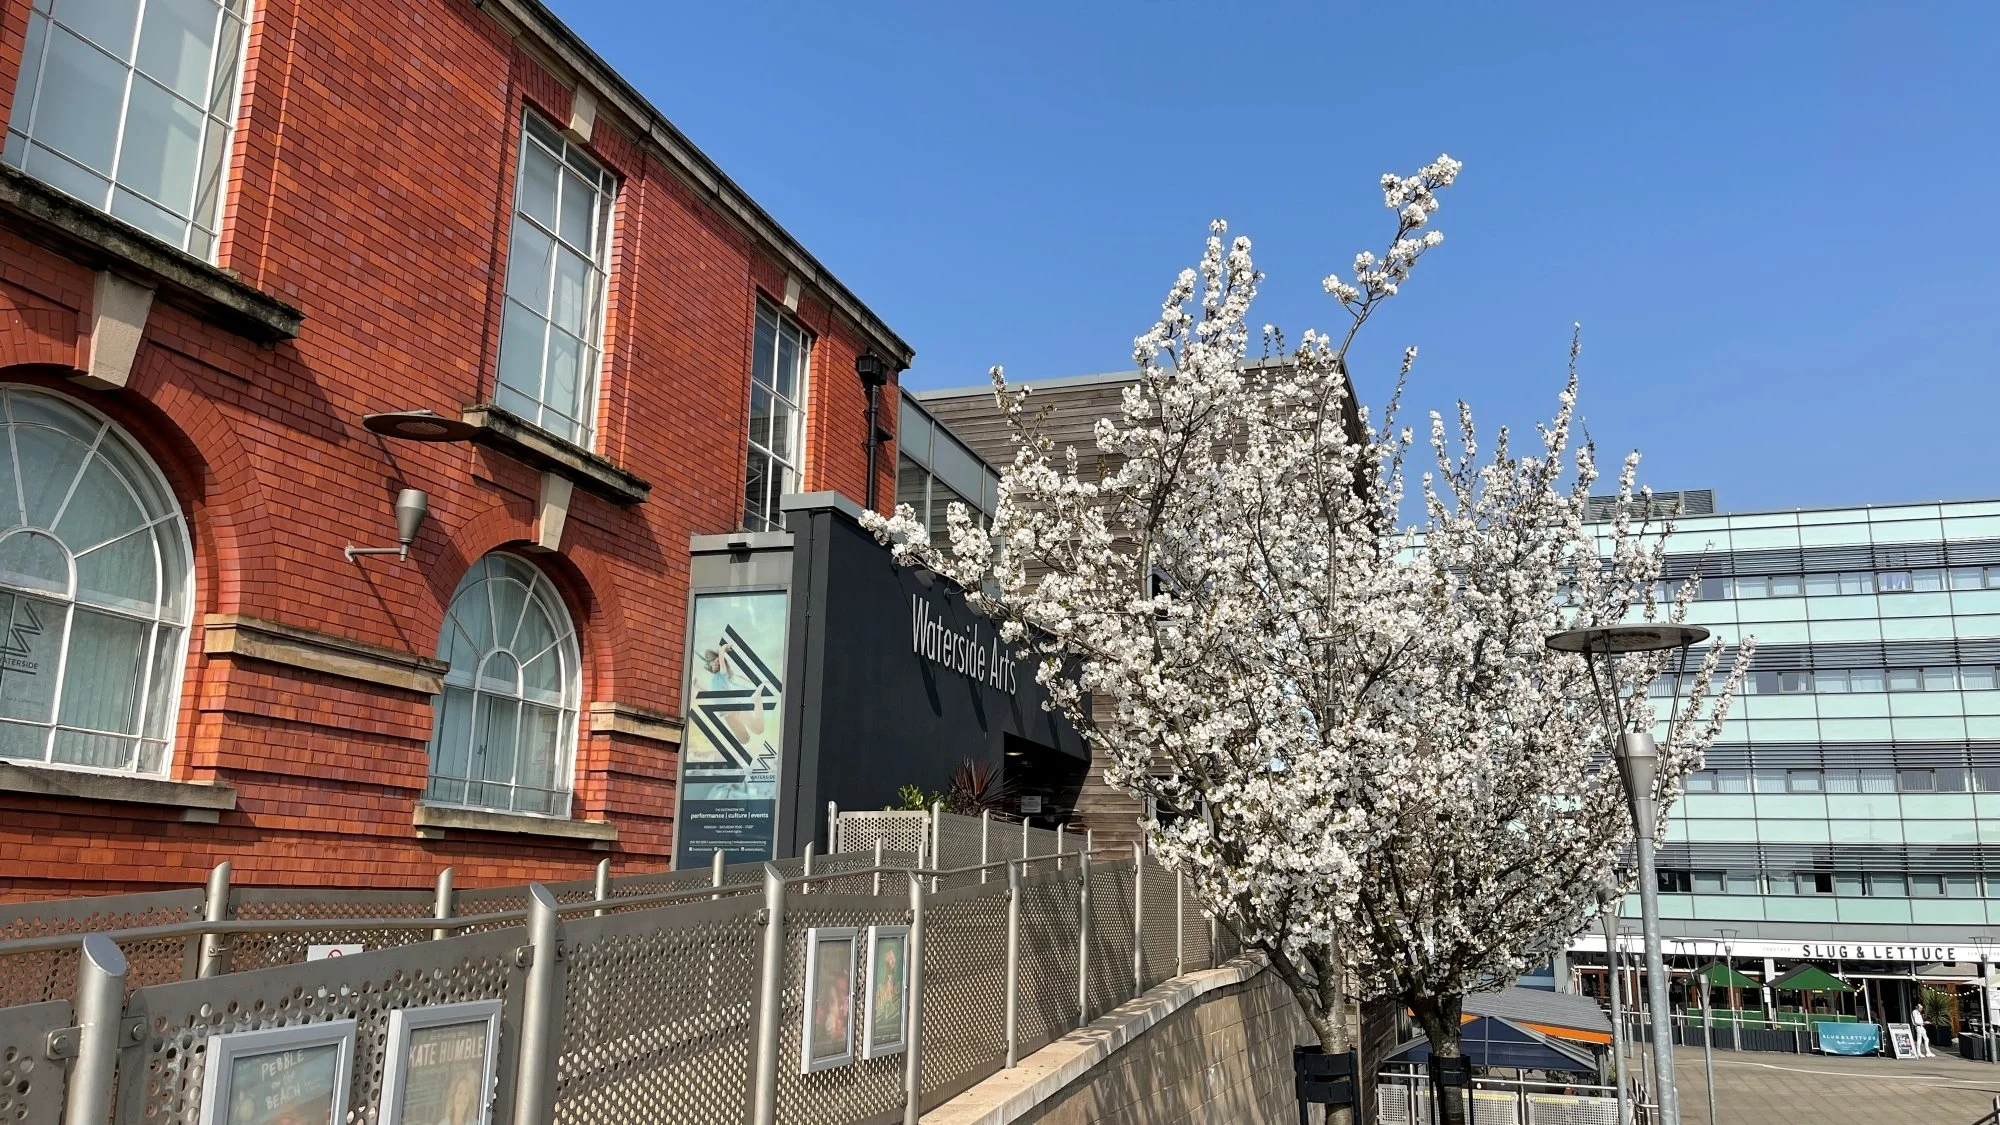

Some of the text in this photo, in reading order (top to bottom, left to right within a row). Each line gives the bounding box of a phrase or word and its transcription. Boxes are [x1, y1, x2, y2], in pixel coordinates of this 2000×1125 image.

[912, 593, 1016, 695] Waterside Arts
[690, 812, 724, 820] performance
[1803, 944, 1956, 960] SLUG & LETTUCE
[261, 1049, 305, 1081] PEBBLE
[408, 1036, 484, 1068] KATE HUMBLE
[264, 1081, 301, 1111] BEACH
